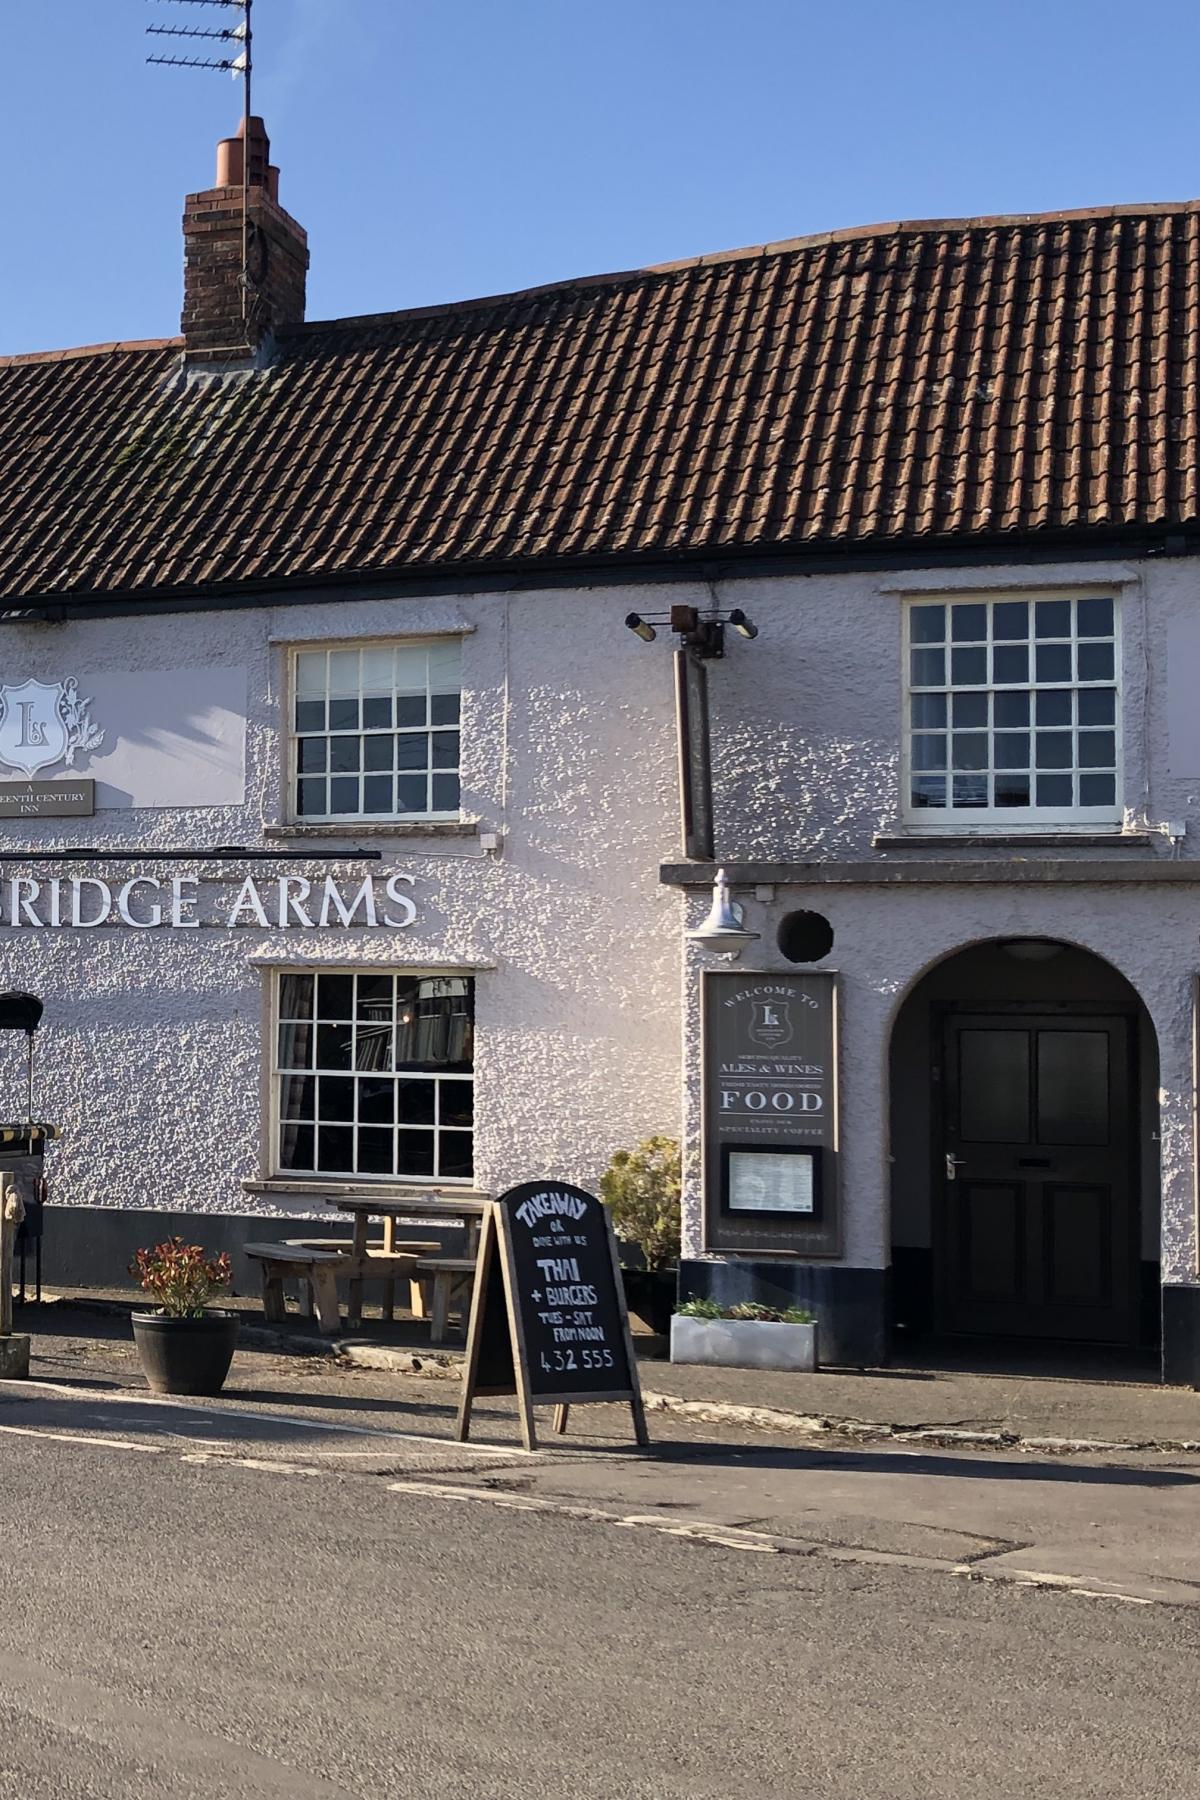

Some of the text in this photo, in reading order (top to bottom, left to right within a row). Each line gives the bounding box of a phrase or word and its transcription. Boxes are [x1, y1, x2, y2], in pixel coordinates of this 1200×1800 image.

[25, 784, 33, 794] A
[36, 793, 86, 803] CENTURY
[20, 804, 39, 813] INN
[227, 874, 418, 928] ARMS
[724, 985, 819, 1009] WELCOME TO
[719, 1063, 824, 1075] ALES & WINES
[720, 1091, 823, 1111] FOOD
[515, 1192, 587, 1228] TAKEAWAY
[536, 1258, 581, 1282] THAI
[546, 1284, 598, 1306] BURGERS
[538, 1311, 563, 1325] TUES
[573, 1311, 593, 1326] SAT
[553, 1326, 606, 1343] FROM NOON
[541, 1349, 614, 1373] 432 555
